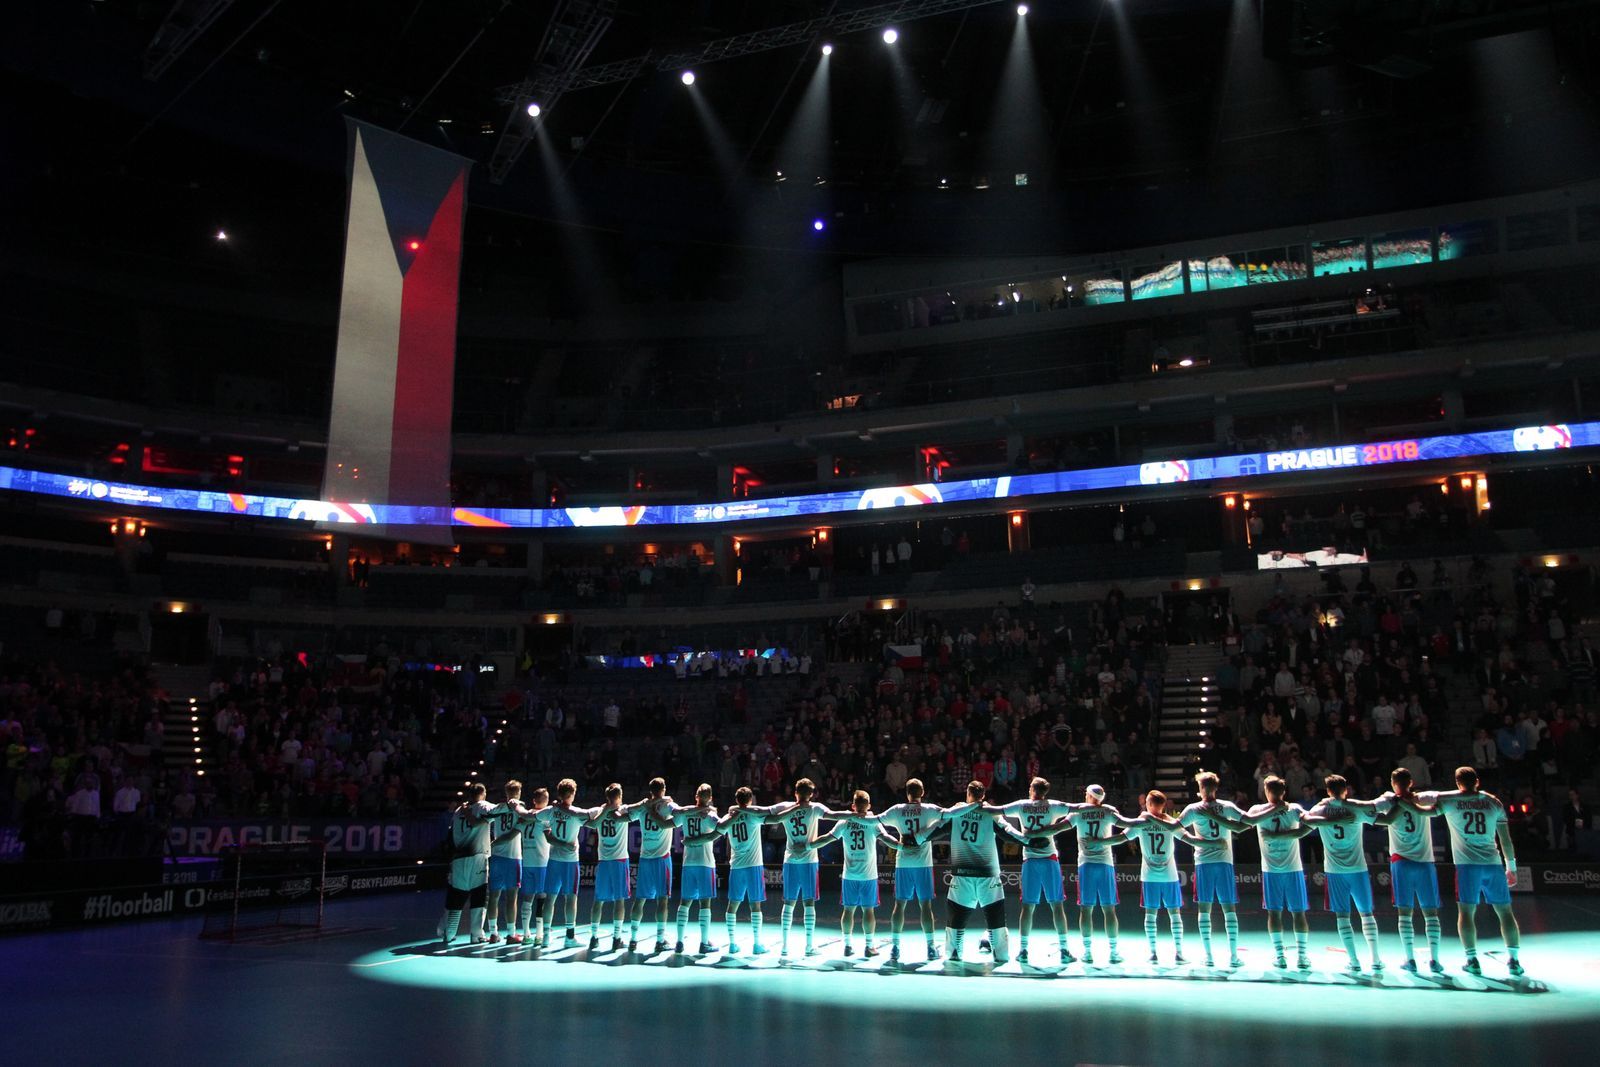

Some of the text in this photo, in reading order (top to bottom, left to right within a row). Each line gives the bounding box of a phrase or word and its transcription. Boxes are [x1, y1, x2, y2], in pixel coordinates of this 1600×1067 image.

[1267, 441, 1419, 471] PRAGUE 2018
[556, 820, 566, 839] 71
[602, 820, 616, 837] 66
[688, 817, 700, 837] 64
[732, 821, 748, 842] 40
[790, 816, 807, 836] 35
[961, 821, 979, 842] 29
[1027, 815, 1044, 831] 25
[1209, 819, 1219, 837] 9
[1272, 817, 1280, 833] 7
[1403, 811, 1415, 832] 3
[1463, 811, 1486, 834] 28
[164, 825, 403, 853] PRAGUE 2018
[850, 830, 865, 850] 33
[1148, 832, 1165, 855] 12
[84, 889, 175, 920] #floorball
